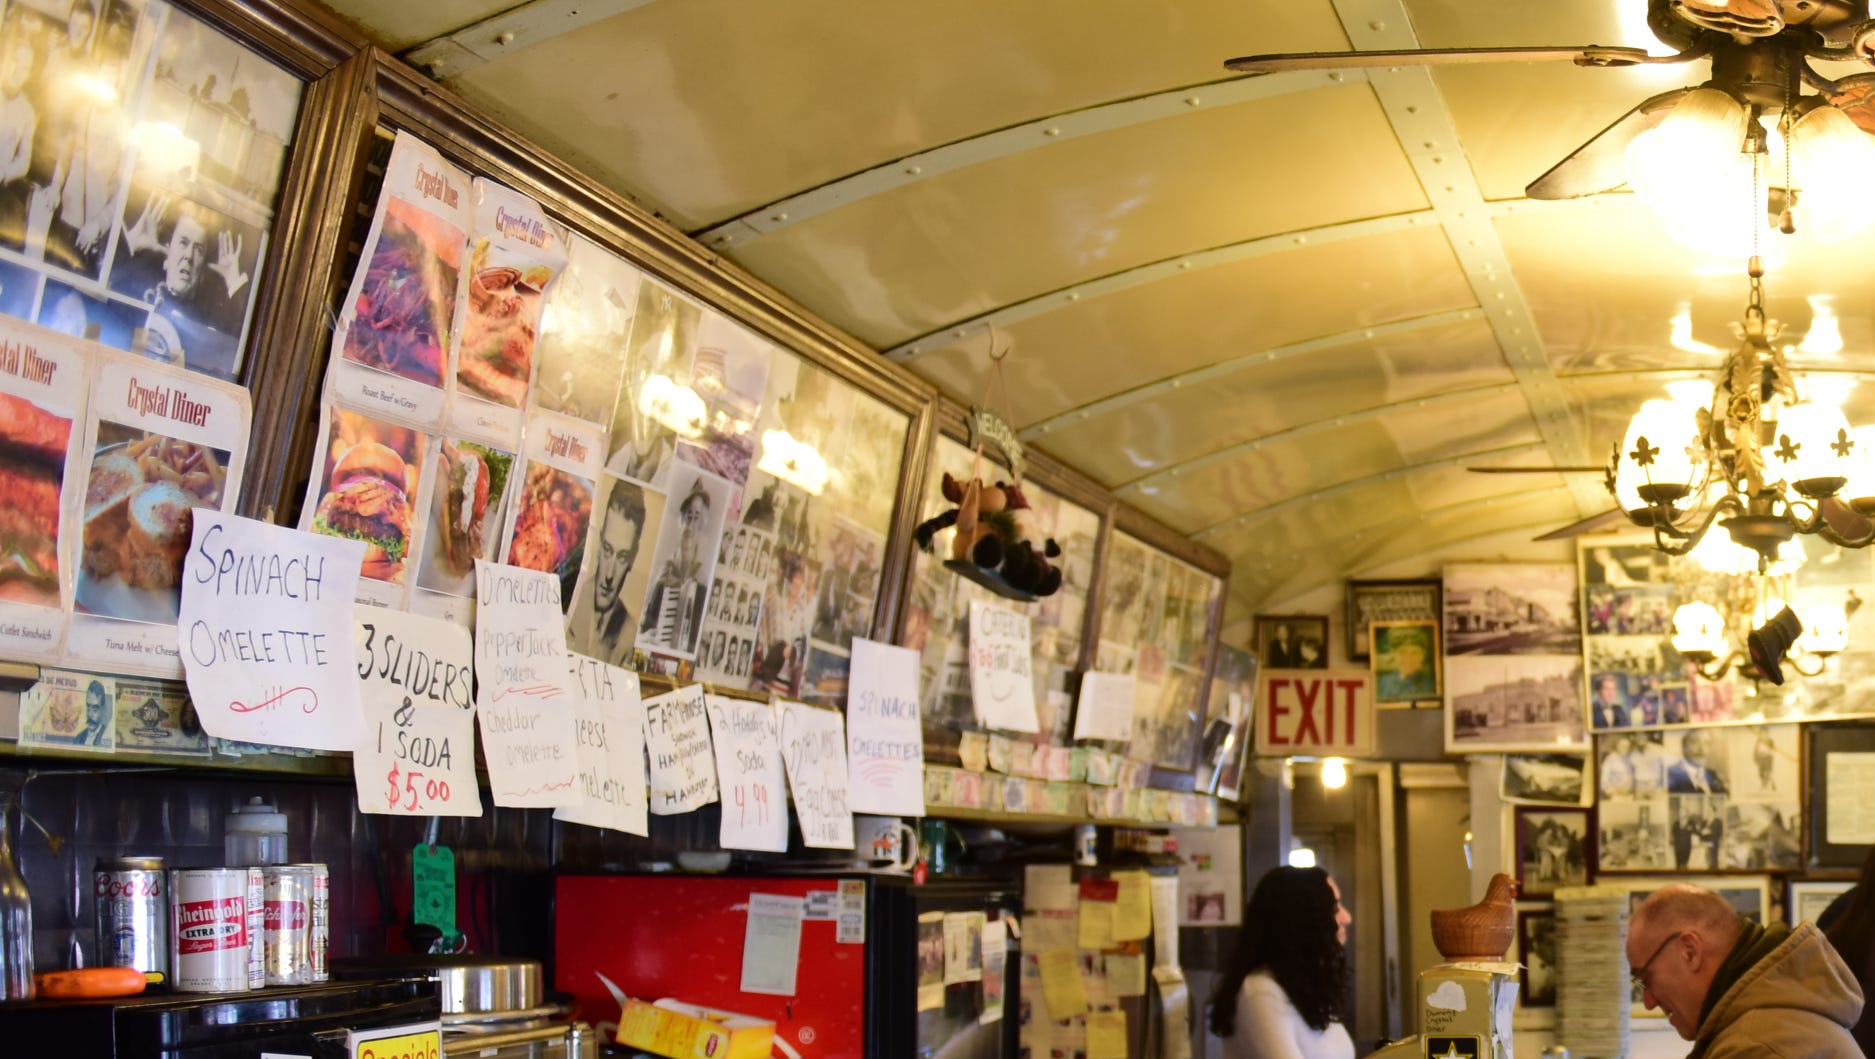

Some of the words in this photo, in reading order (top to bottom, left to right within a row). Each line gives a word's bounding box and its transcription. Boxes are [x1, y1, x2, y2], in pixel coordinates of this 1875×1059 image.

[496, 206, 530, 242] Crystal
[21, 346, 57, 387] Diner
[127, 377, 169, 418] Crystal
[171, 390, 211, 427] Diner
[361, 384, 379, 401] Roast
[379, 391, 395, 406] Beef
[195, 524, 325, 602] SPINACH
[21, 624, 53, 641] Sandwich
[105, 637, 125, 651] Tuna
[126, 640, 143, 653] Melt
[154, 645, 180, 658] Cheese
[190, 620, 329, 667] OMELETTE
[357, 624, 376, 681] 3
[378, 634, 473, 711] SLIDERS
[393, 695, 416, 728] &
[859, 689, 916, 721] SPINACH
[1268, 679, 1364, 747] EXIT
[395, 730, 452, 771] SODA
[736, 749, 765, 775] Soda
[384, 761, 452, 812] $5.00
[94, 873, 161, 898] Coors
[176, 896, 244, 926] Rheingold
[186, 927, 216, 938] EXTRA
